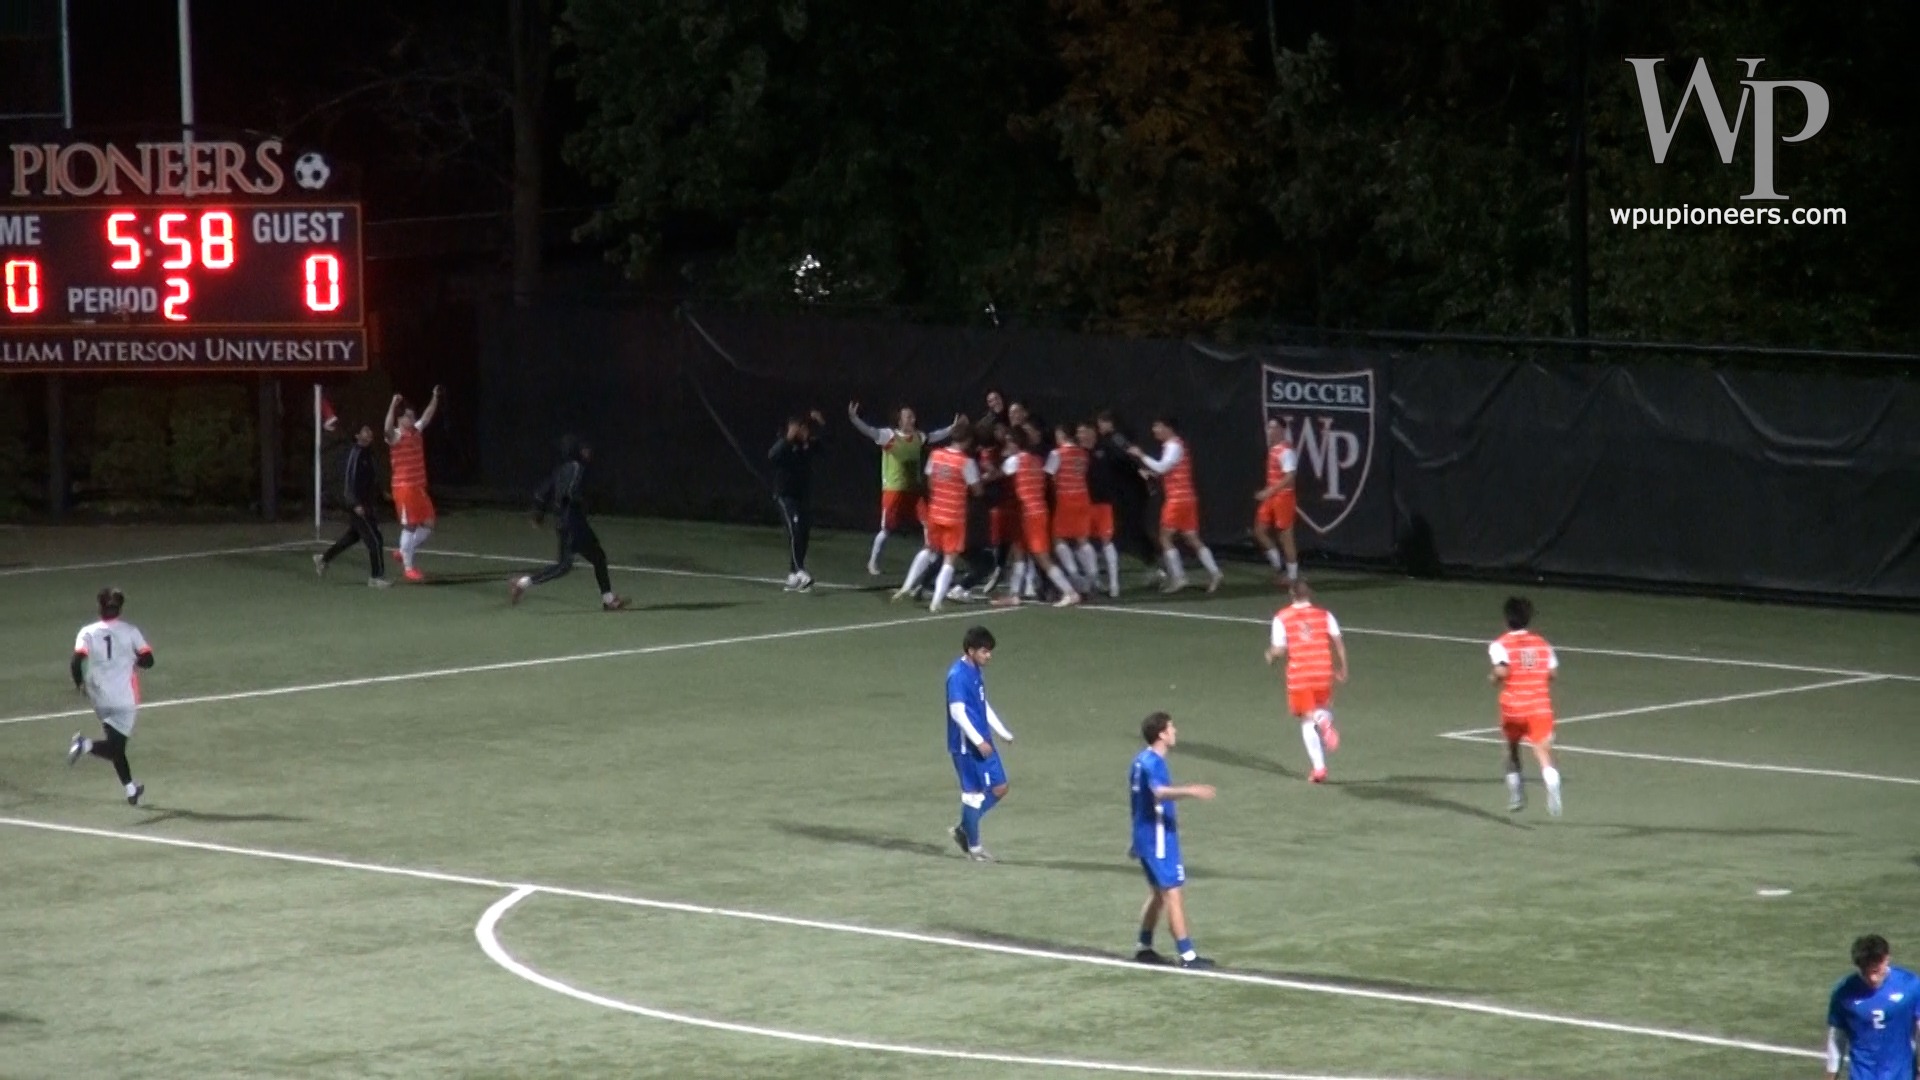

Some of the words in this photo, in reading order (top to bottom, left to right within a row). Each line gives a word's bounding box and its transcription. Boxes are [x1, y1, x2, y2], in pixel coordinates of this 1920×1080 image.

[10, 141, 285, 197] PIONEERS
[106, 211, 235, 270] 5:58
[252, 211, 345, 243] GUEST
[4, 258, 40, 314] 0
[304, 253, 340, 312] 0
[67, 286, 158, 314] PERIOD
[163, 277, 191, 321] 2
[0, 341, 64, 362] LIAM
[1270, 380, 1367, 405] SOCCER
[103, 634, 112, 661] 1
[1871, 1009, 1886, 1030] 2
